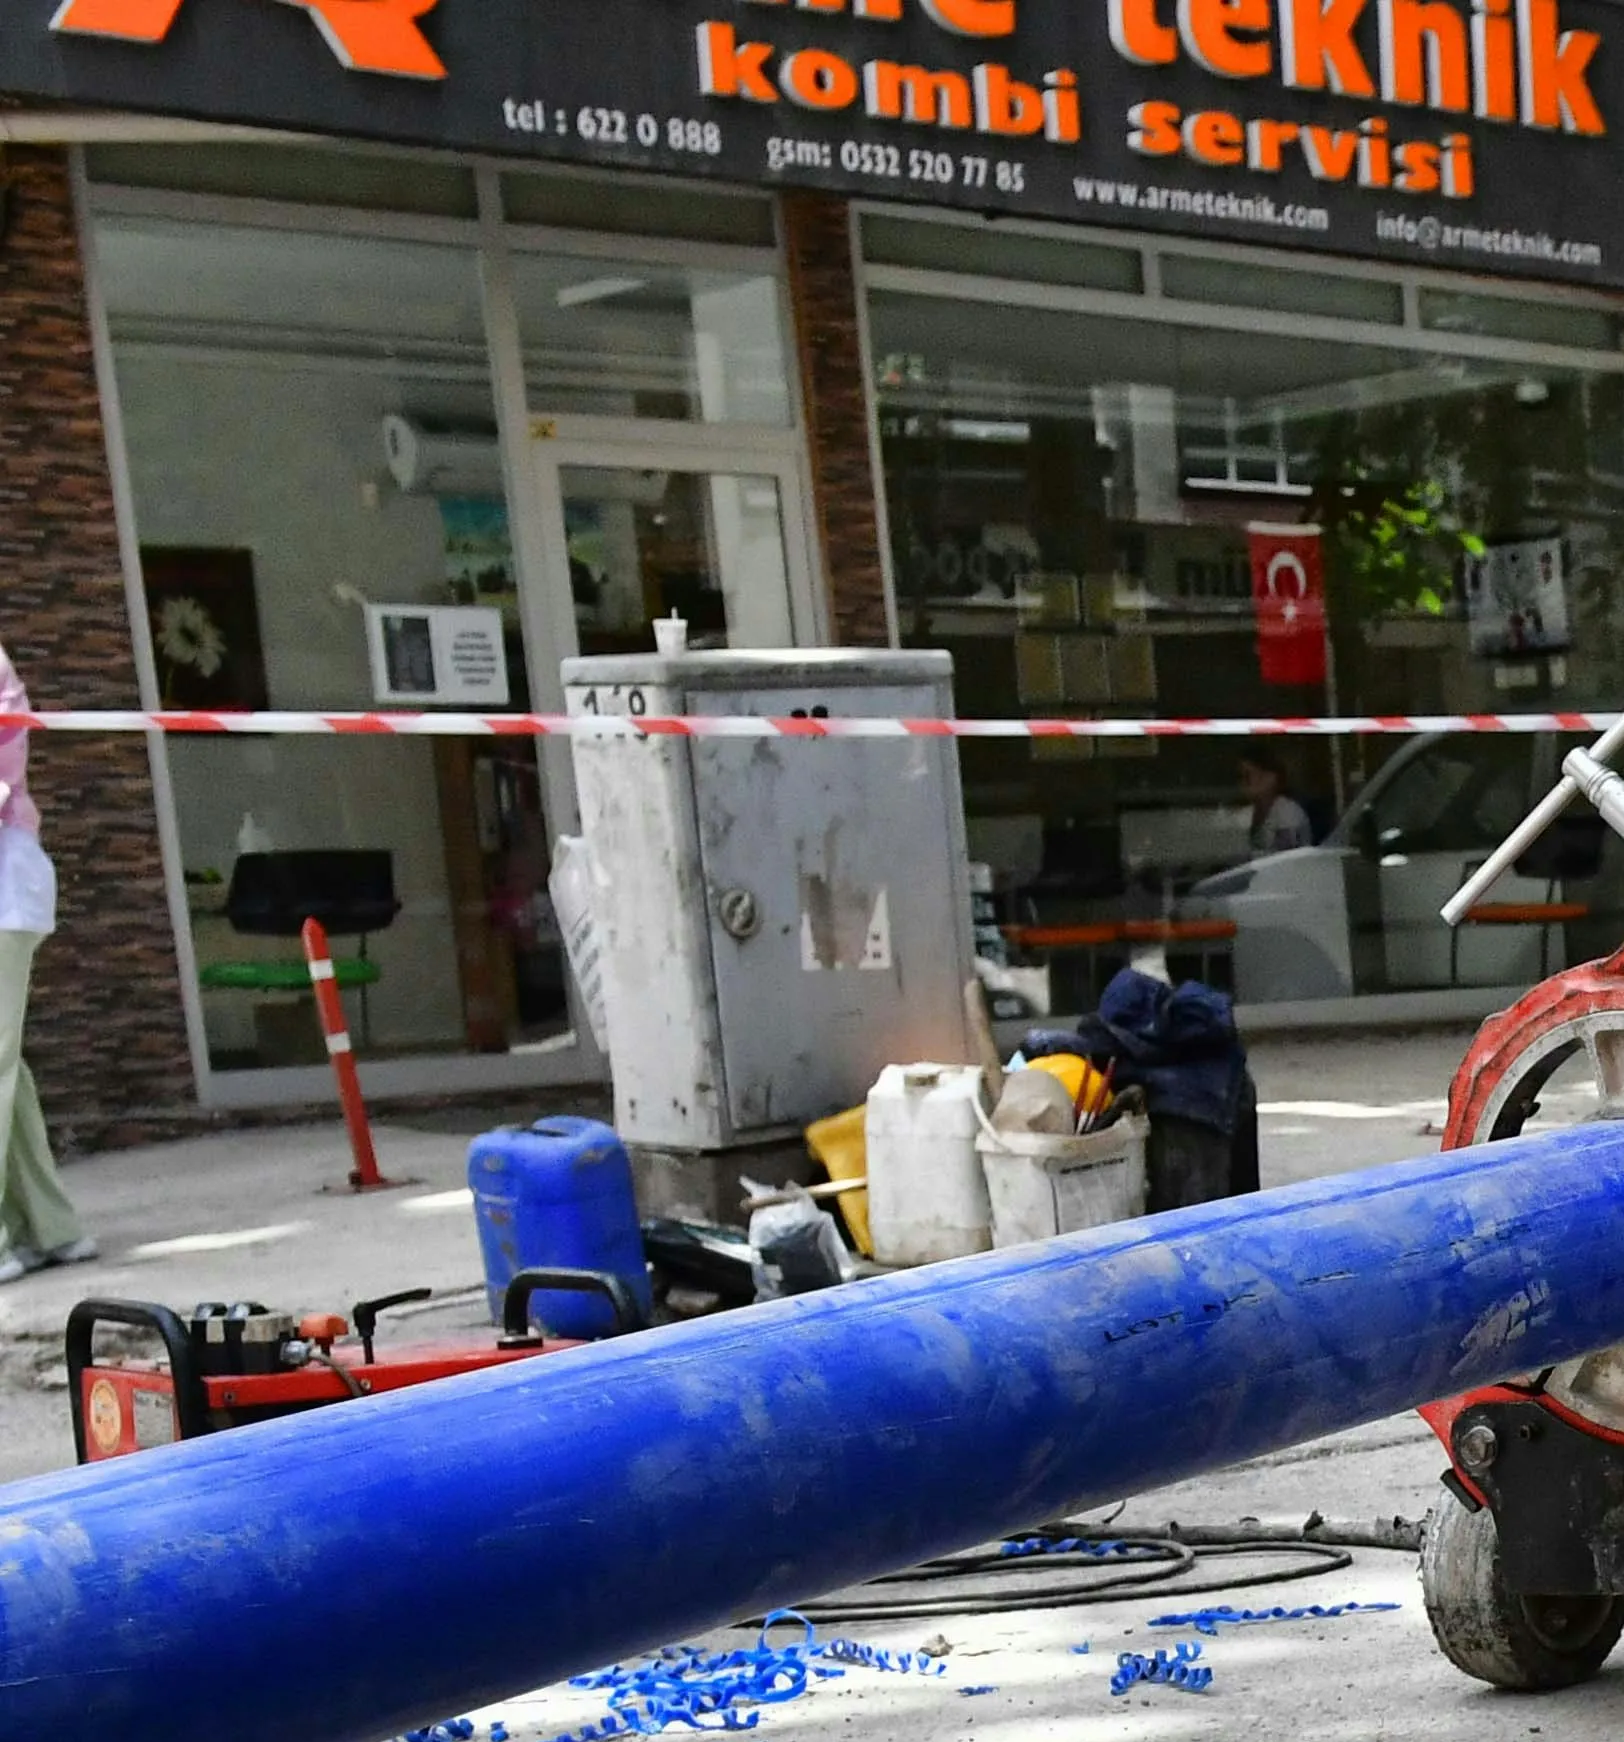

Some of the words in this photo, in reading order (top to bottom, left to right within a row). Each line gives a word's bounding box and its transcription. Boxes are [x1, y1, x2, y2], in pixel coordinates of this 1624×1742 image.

[503, 98, 545, 132] tel
[577, 106, 628, 143] 622
[636, 113, 658, 147] 0
[667, 117, 722, 155] 888
[697, 21, 1080, 144] kombi
[1127, 100, 1475, 198] servisi
[767, 137, 832, 171] gsm:
[840, 141, 900, 177] 0532
[908, 149, 953, 183] 520
[961, 156, 988, 188] 77
[996, 160, 1025, 192] 85
[1073, 177, 1329, 231] www.armeteknik.com
[1376, 211, 1601, 265] info@armeteknik.com
